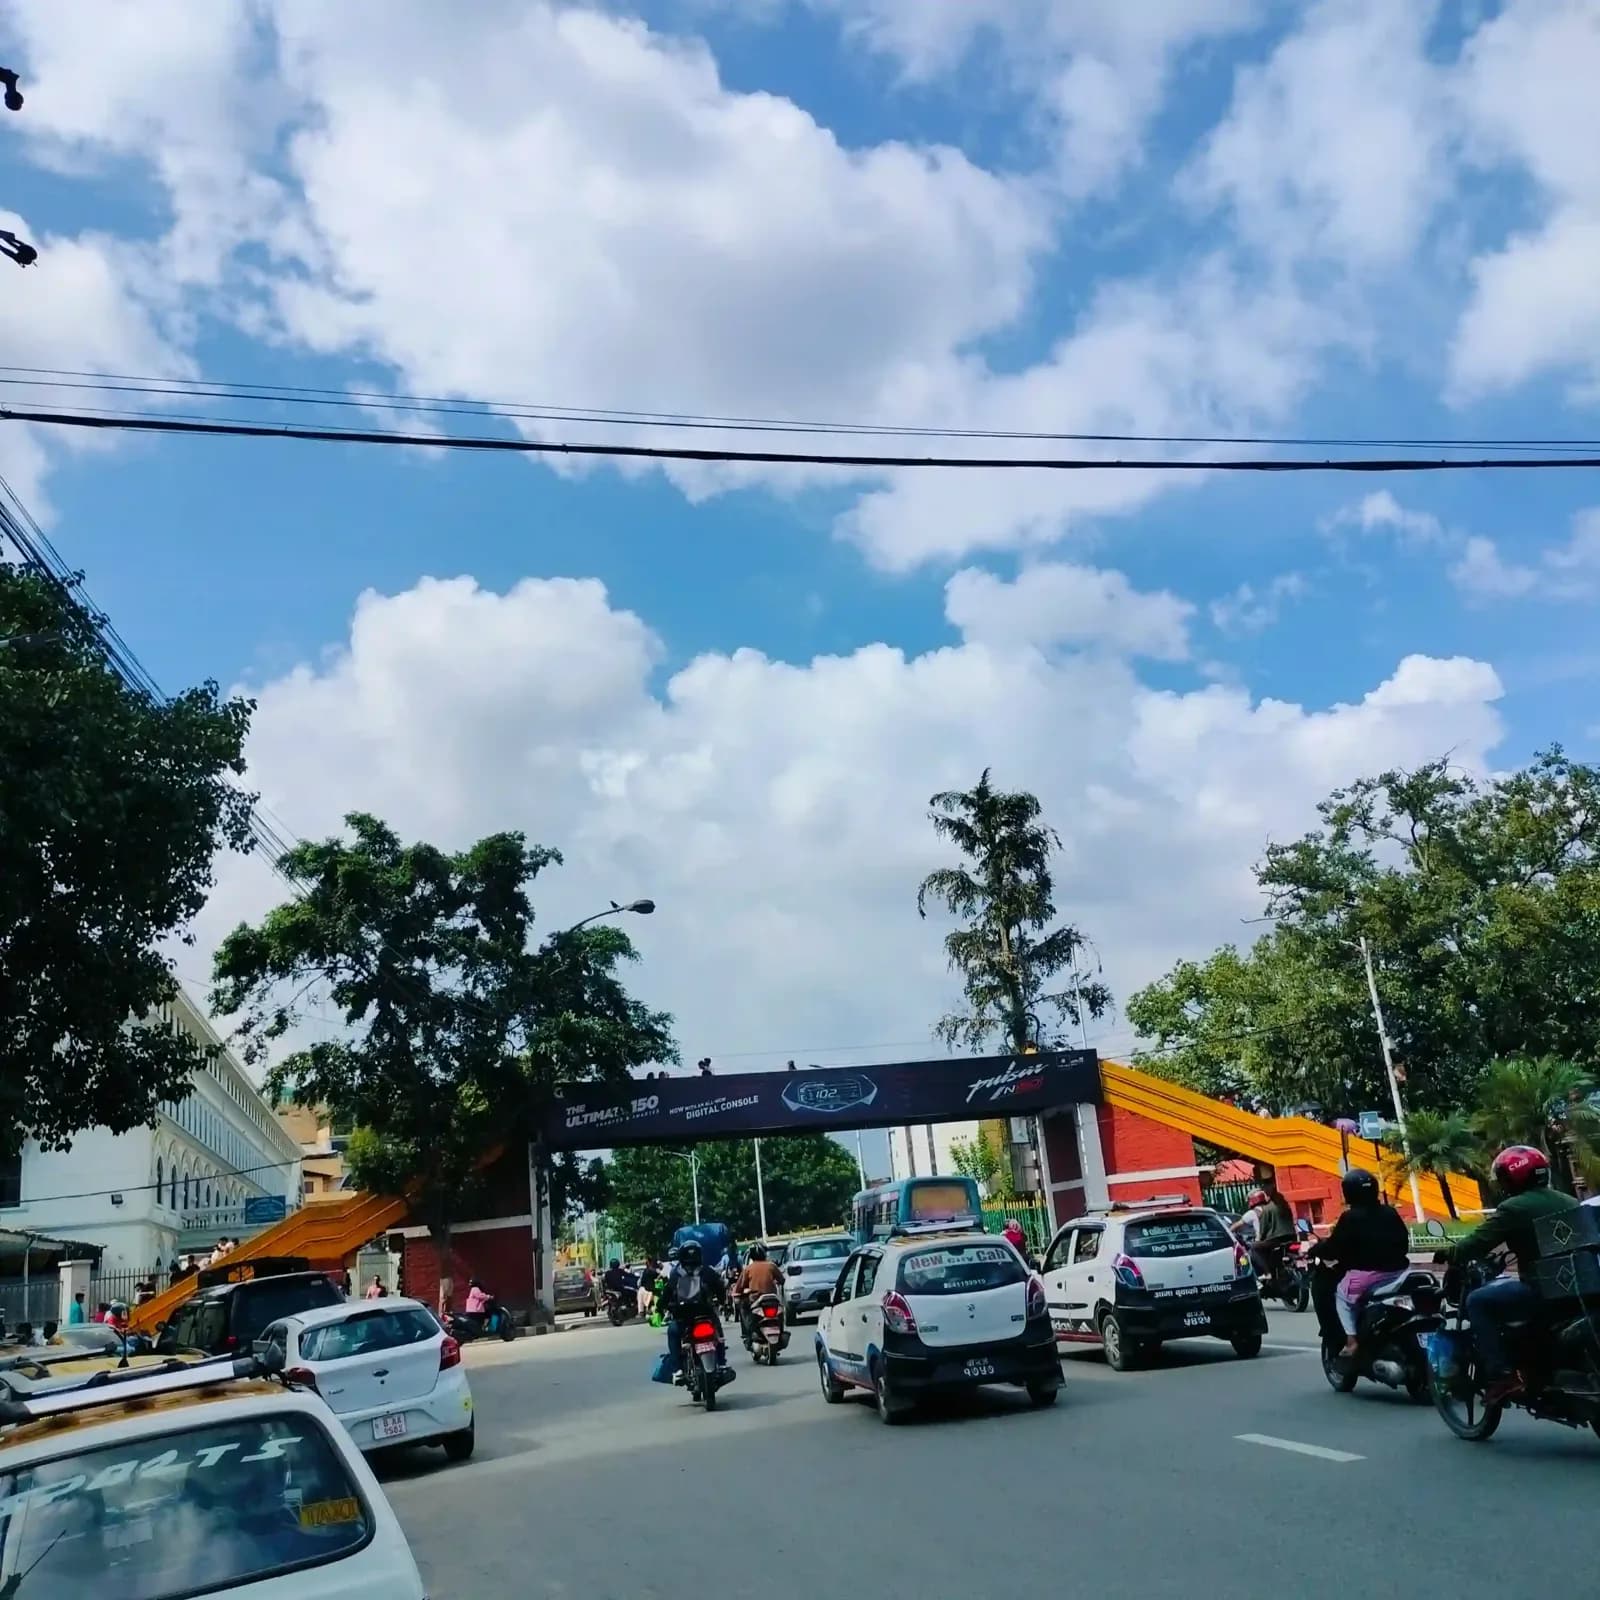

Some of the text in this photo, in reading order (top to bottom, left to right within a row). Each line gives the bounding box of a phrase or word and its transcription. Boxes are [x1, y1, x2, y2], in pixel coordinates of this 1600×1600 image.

[816, 1089, 838, 1099] 102
[565, 1104, 586, 1116] THE
[565, 1106, 629, 1128] ULTIMAT
[631, 1095, 659, 1113] 150
[686, 1095, 759, 1120] DIGITAL CONSOLE
[976, 1249, 1006, 1262] Cab
